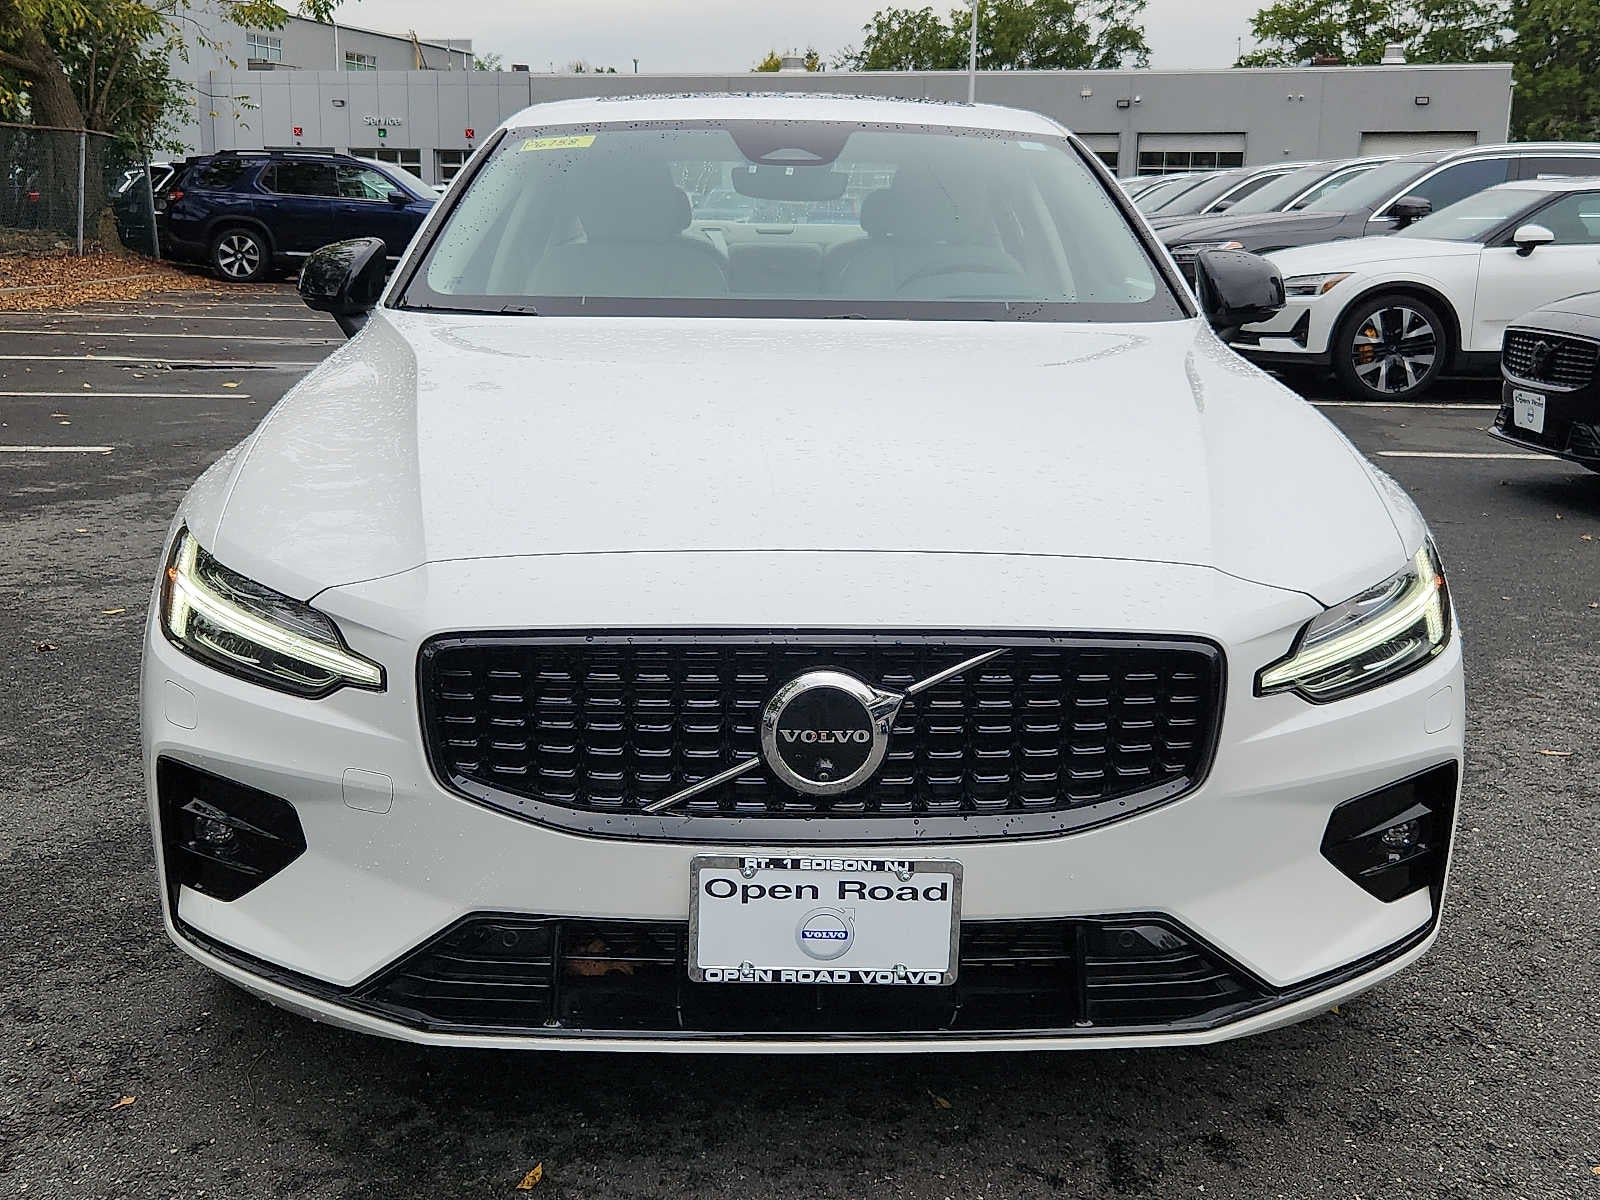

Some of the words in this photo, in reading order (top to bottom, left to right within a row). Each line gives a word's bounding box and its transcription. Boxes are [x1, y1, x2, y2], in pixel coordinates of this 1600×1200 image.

[363, 115, 401, 127] Service
[779, 729, 870, 744] VOLVO
[783, 858, 792, 869] 1
[800, 859, 878, 871] EDISON,
[885, 861, 909, 873] NJ
[704, 878, 819, 905] Open
[838, 880, 948, 902] Road
[804, 930, 847, 939] VOLVO
[704, 968, 773, 983] OPEN
[781, 970, 851, 983] ROAD
[858, 971, 942, 984] VOLVO
